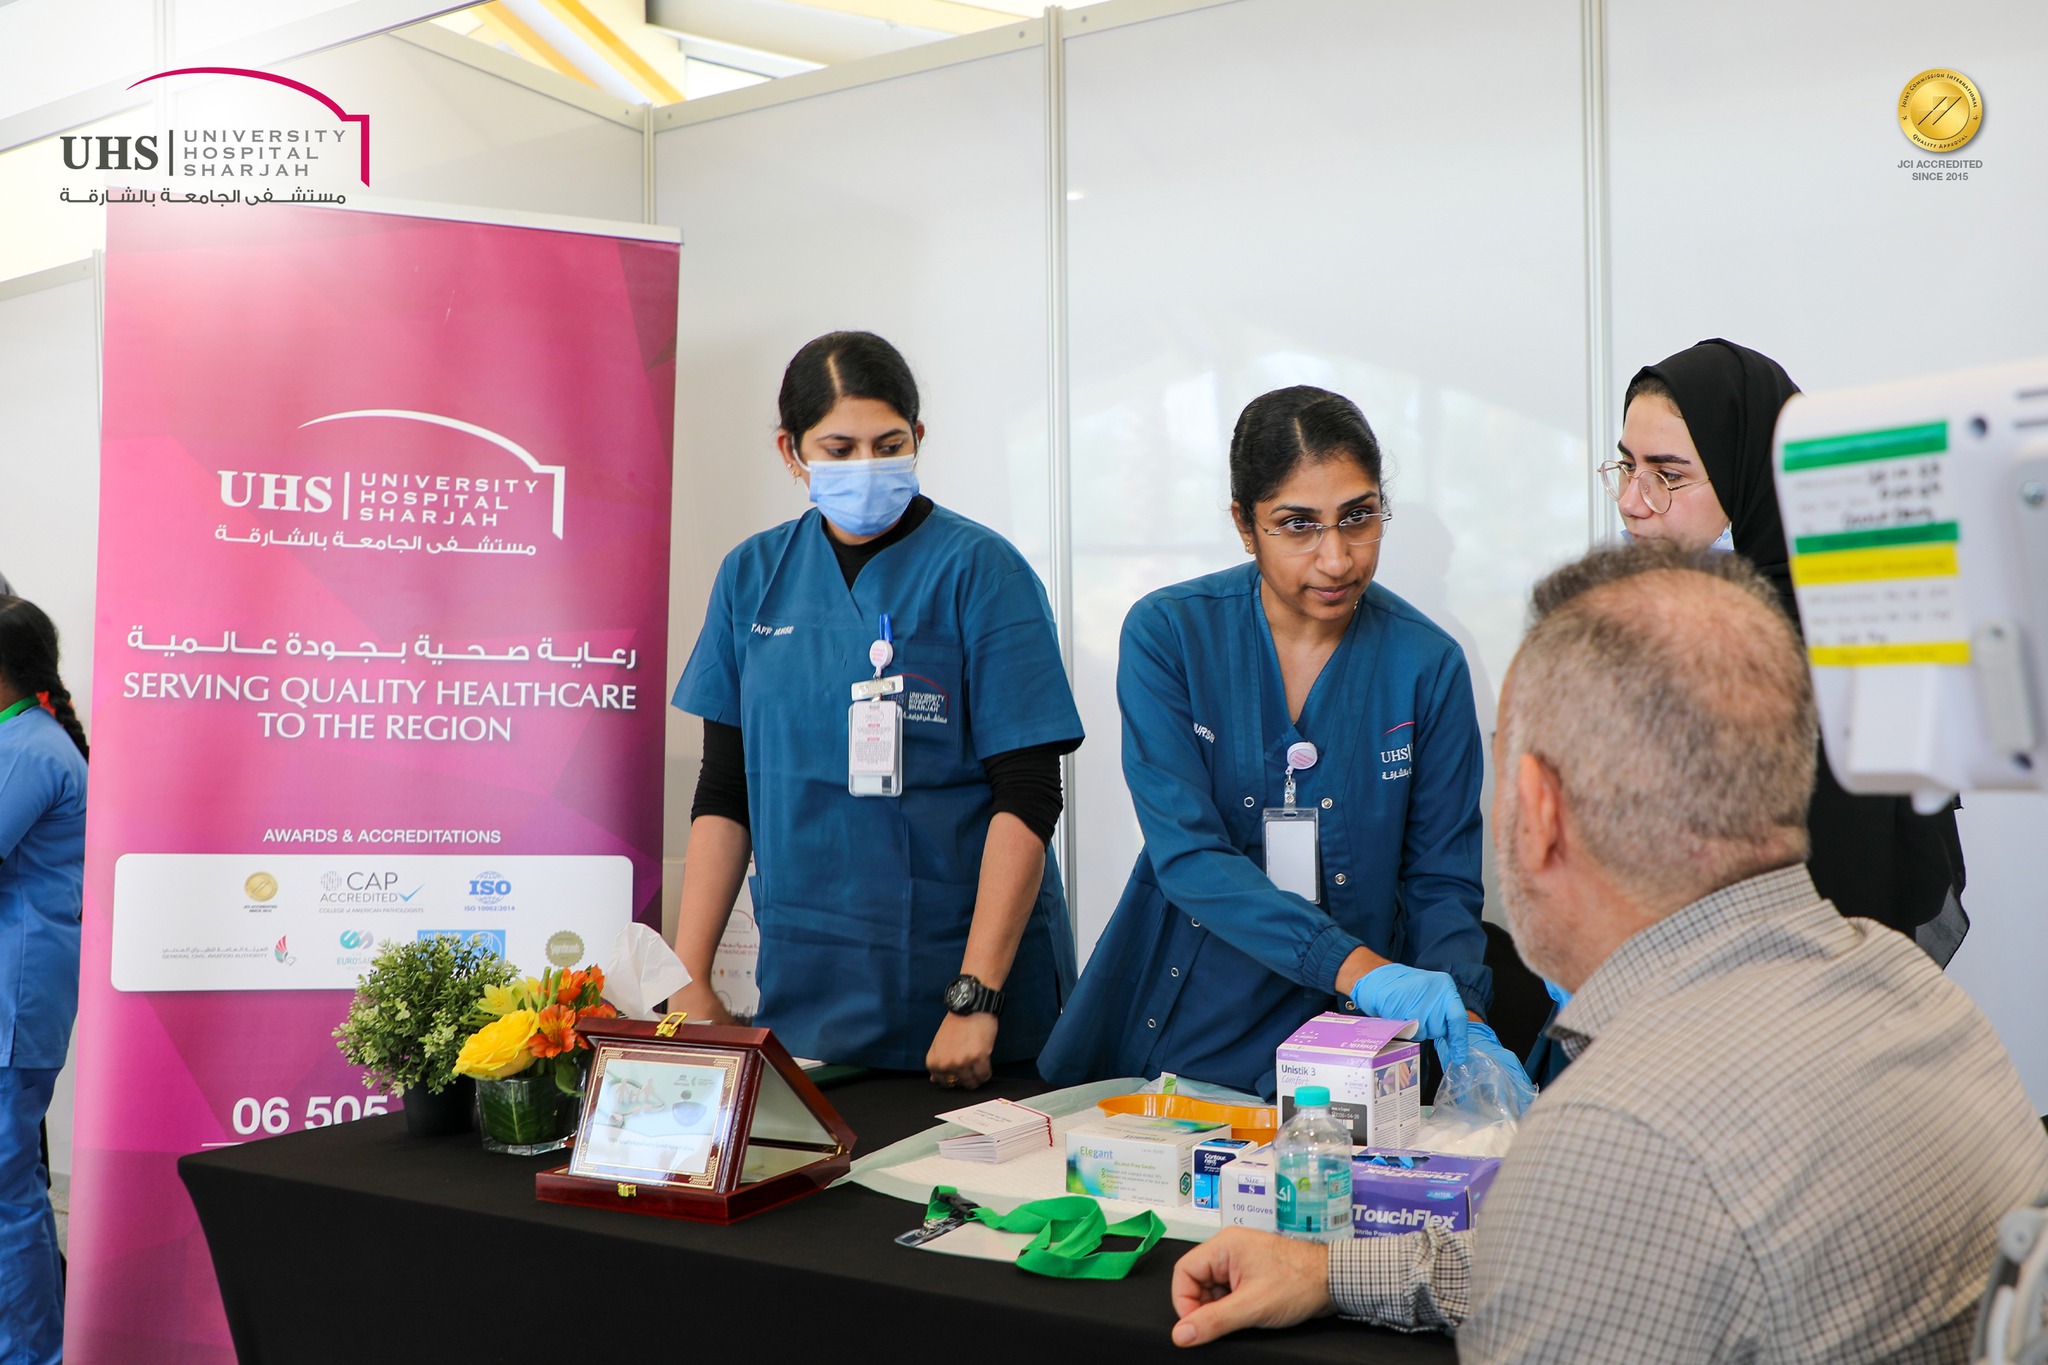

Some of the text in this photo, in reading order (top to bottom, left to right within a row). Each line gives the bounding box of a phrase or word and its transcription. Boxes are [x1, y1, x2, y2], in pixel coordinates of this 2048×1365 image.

[217, 469, 334, 513] UHS
[360, 472, 539, 495] UNIVERSITY
[360, 490, 511, 510] HOSPITAL
[359, 506, 499, 527] SHARJAH
[214, 523, 537, 556] مستشفى الجامعة بالشارقة
[285, 631, 410, 665] بجودة
[414, 633, 530, 666] صحية
[537, 638, 637, 669] رعاية
[122, 671, 637, 711] SERVING QUALITY HEALTHCARE
[257, 711, 512, 743] TO THE REGION
[1380, 747, 1408, 764] UHS
[262, 828, 502, 845] AWARDS & ACCREDITATIONS
[346, 871, 398, 891] CAP
[469, 880, 512, 896] ISO
[320, 892, 398, 903] ACCREDITED
[336, 957, 375, 966] EUROSAF
[1281, 1064, 1316, 1076] Unistik 3
[232, 1095, 388, 1135] 06 505
[1080, 1146, 1114, 1160] Elegant
[1244, 1176, 1259, 1184] Size
[1249, 1185, 1255, 1194] S
[1232, 1204, 1244, 1212] 100
[1247, 1206, 1274, 1215] Gloves
[1352, 1204, 1456, 1229] TouchFlex
